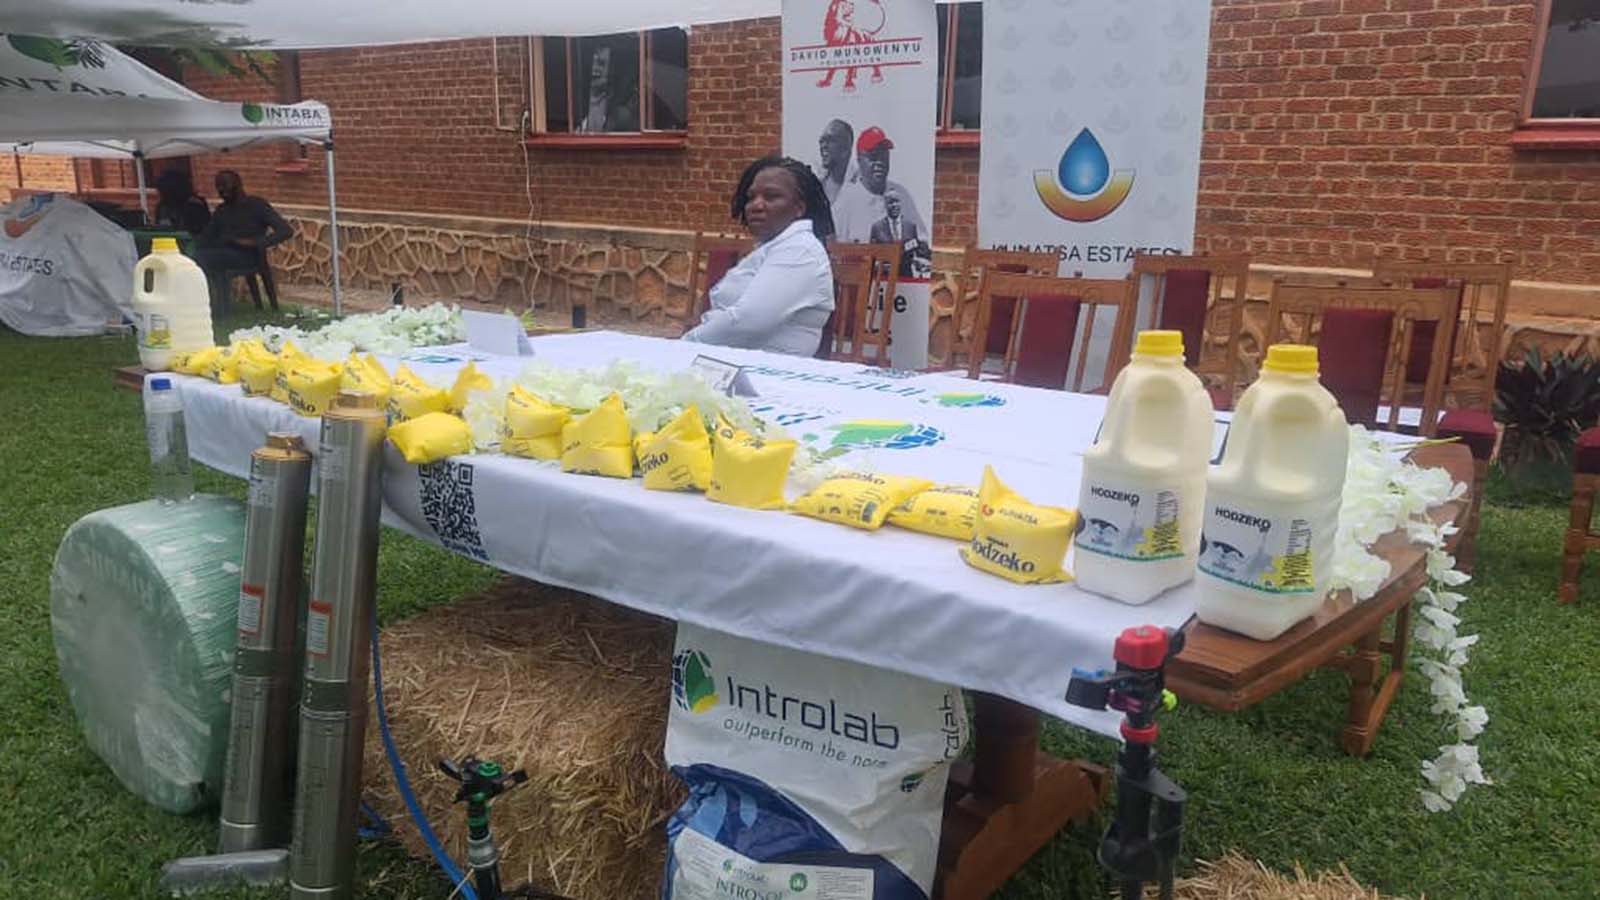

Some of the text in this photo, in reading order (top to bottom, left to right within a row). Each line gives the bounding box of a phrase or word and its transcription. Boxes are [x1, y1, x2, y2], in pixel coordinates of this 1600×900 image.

[791, 50, 828, 62] DAVID
[266, 107, 322, 119] INTABA
[1087, 245, 1182, 263] ESTA
[1091, 486, 1141, 505] HODZEKO
[1215, 506, 1272, 530] HODZEKO
[727, 676, 900, 749] Introlab
[723, 718, 814, 752] outperform
[820, 739, 848, 761] the
